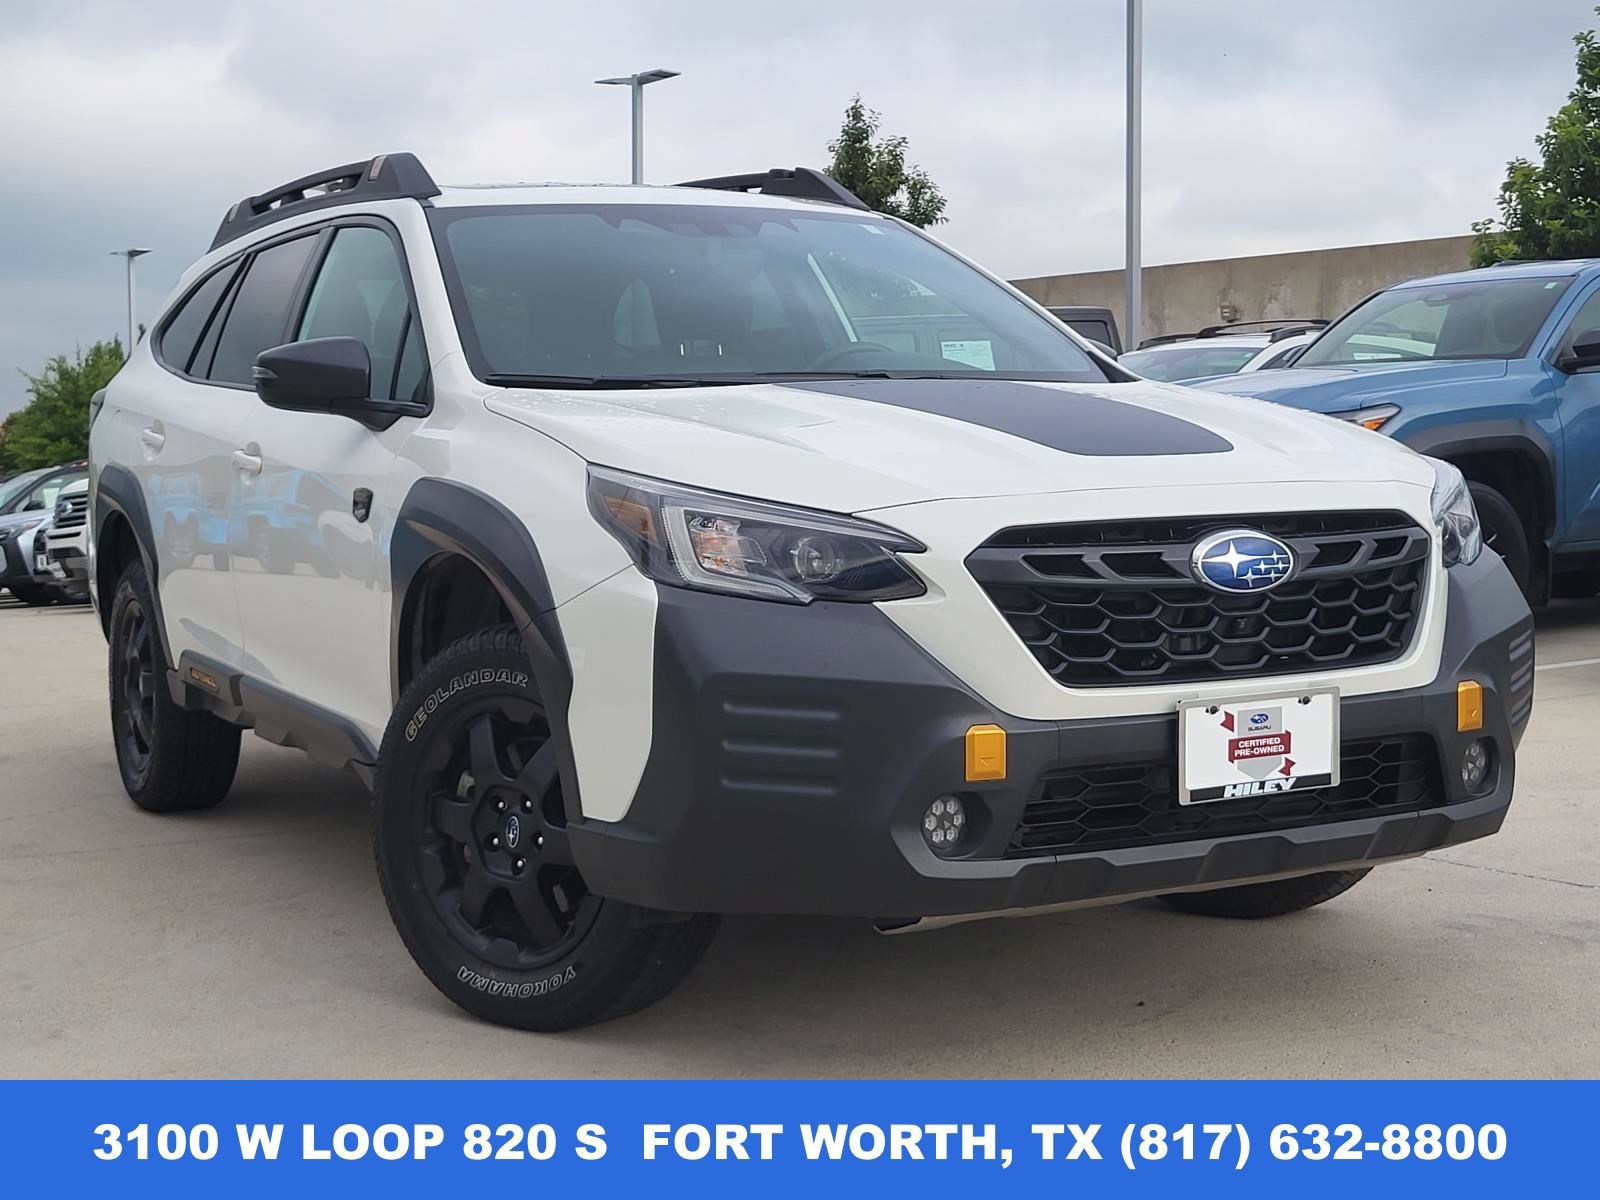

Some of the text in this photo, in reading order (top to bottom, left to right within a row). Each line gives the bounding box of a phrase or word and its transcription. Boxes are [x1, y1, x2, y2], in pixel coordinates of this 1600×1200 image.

[405, 668, 528, 742] GEOLANDAR
[1234, 744, 1285, 758] PRE-OWNED
[1238, 737, 1281, 749] CERTIFIED
[1223, 777, 1297, 798] HILEY
[457, 965, 577, 998] YOKOHAMA
